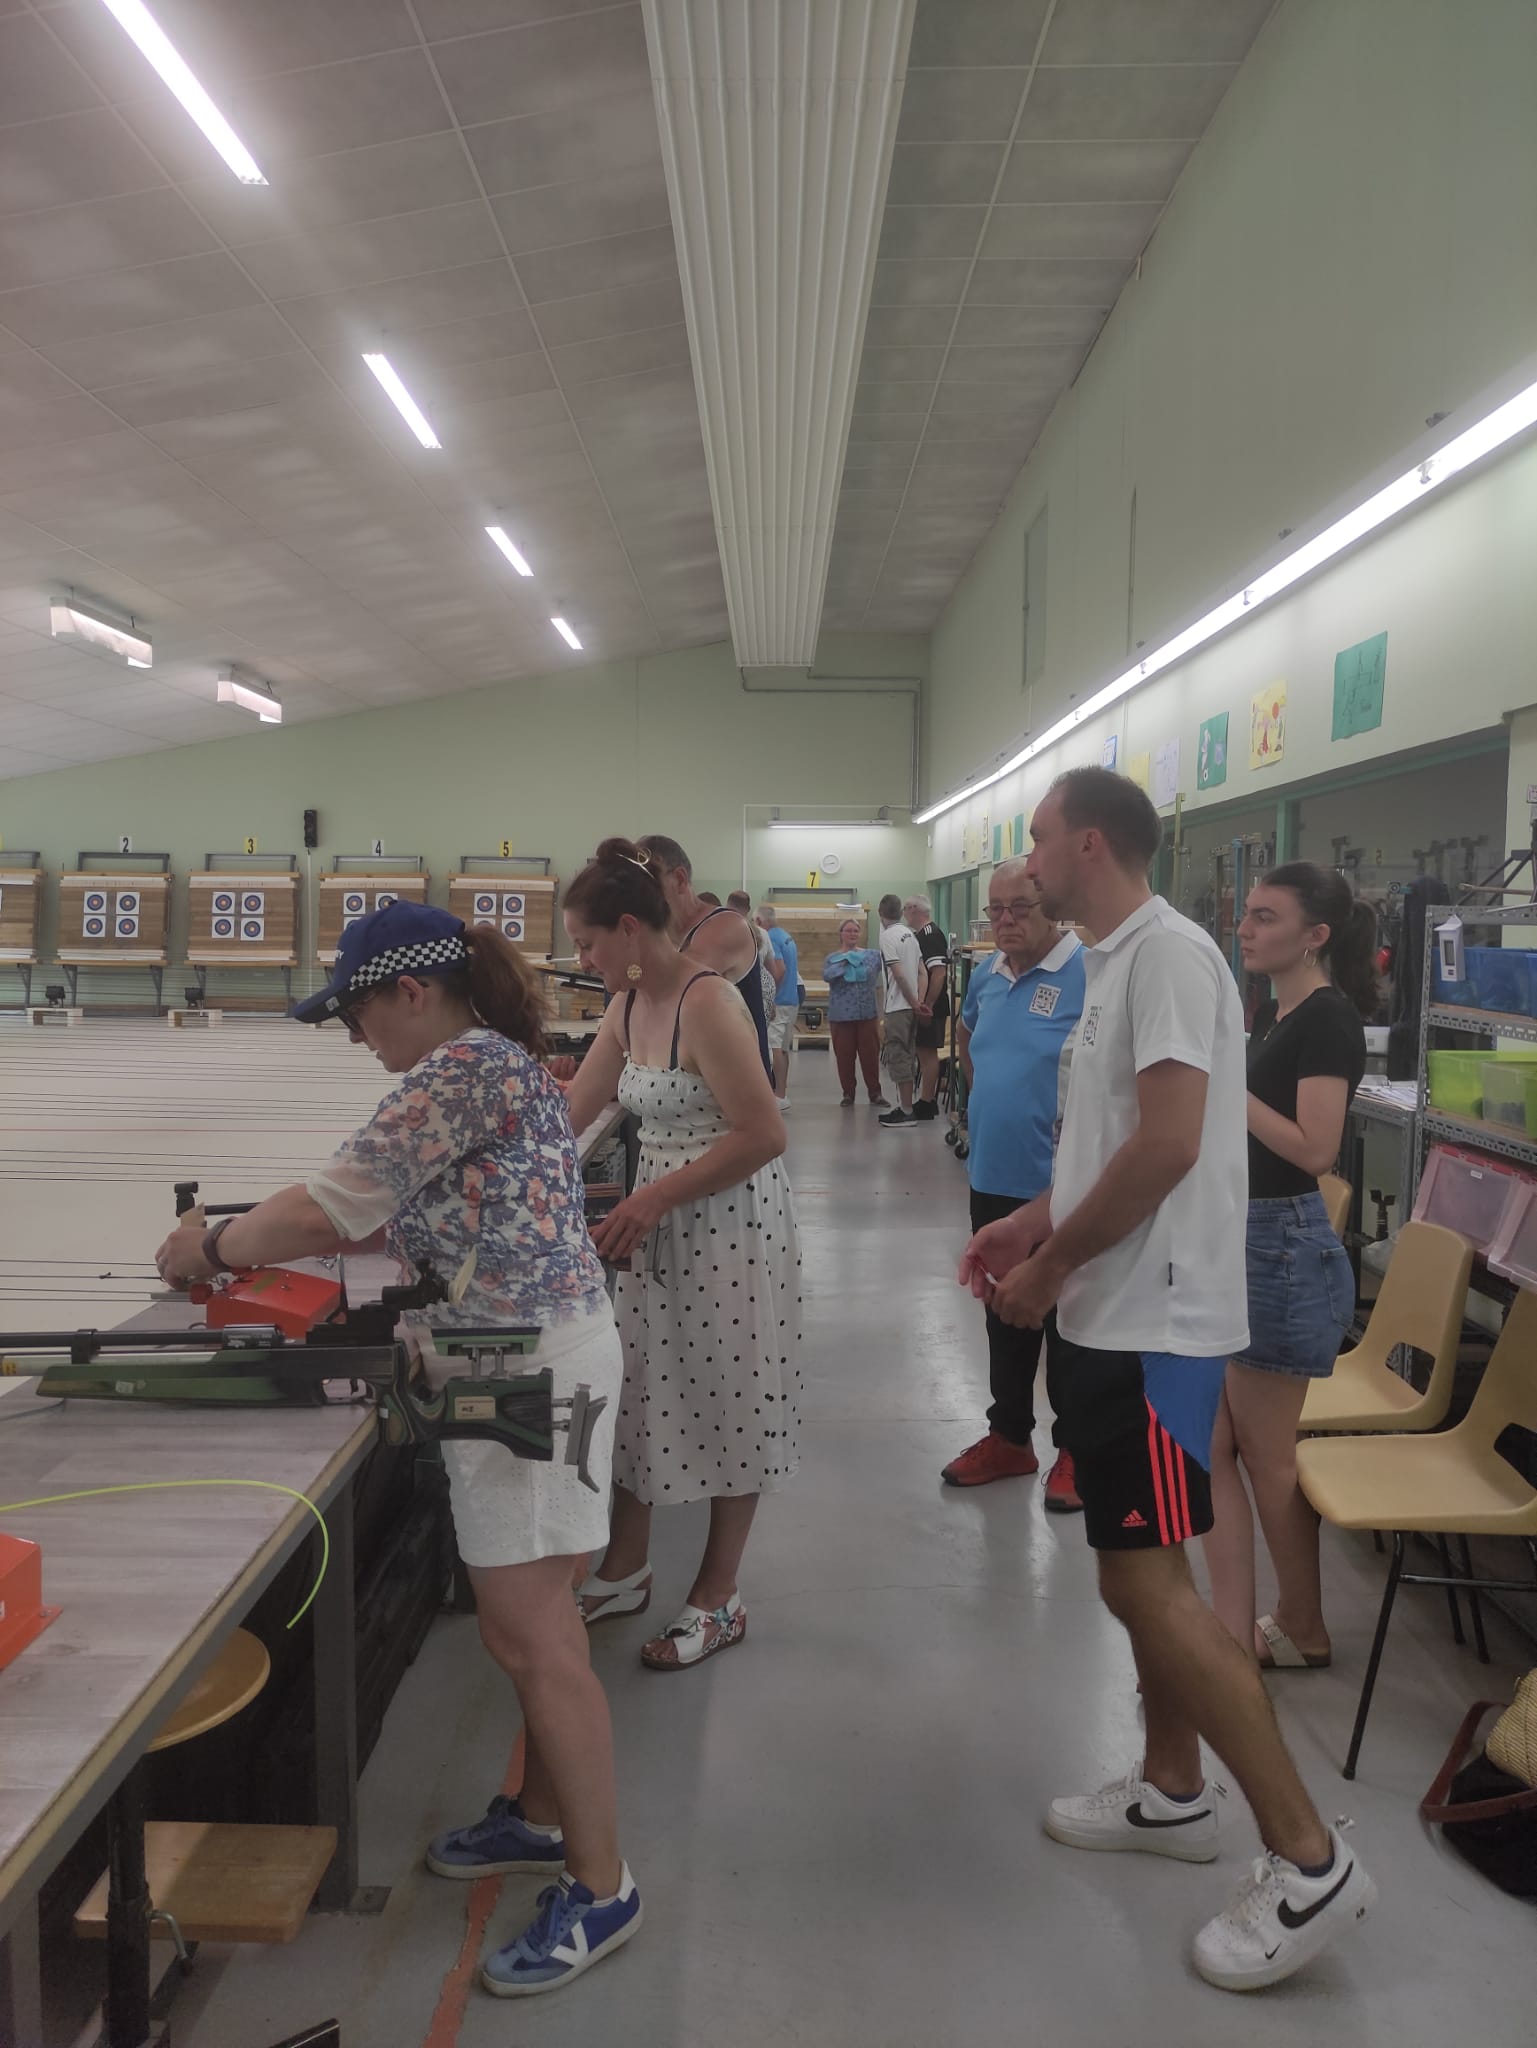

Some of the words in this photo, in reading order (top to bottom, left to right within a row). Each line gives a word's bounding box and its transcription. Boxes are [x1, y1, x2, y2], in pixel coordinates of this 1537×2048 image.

[122, 837, 129, 853] 2
[247, 838, 254, 854] 3
[375, 840, 382, 857] 4
[503, 841, 509, 857] 5
[810, 872, 817, 887] 7
